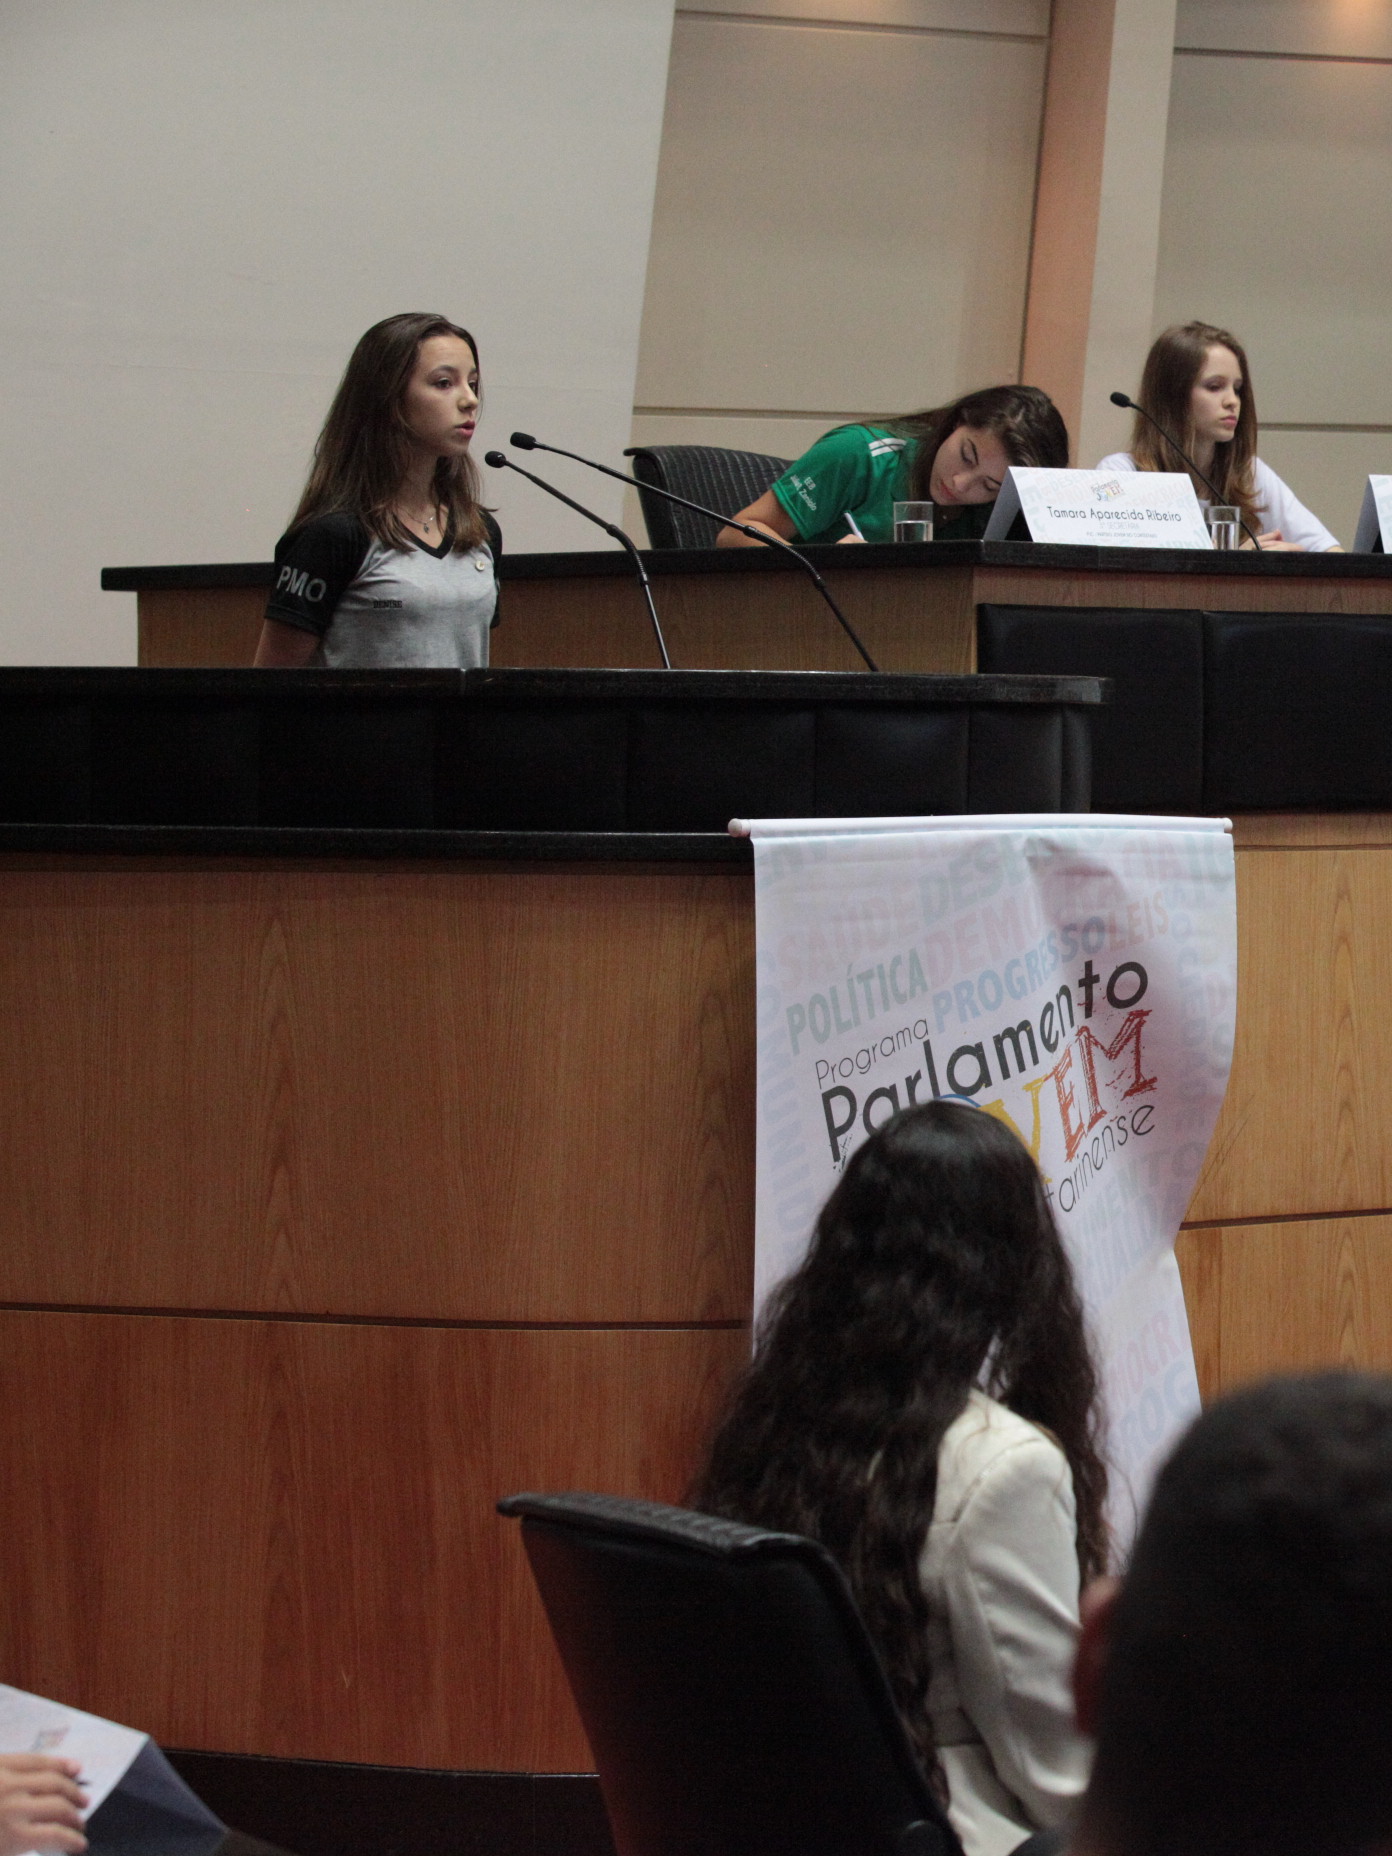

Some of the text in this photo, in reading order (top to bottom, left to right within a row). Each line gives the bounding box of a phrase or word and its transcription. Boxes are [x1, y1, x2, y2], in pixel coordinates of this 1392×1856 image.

[1047, 506, 1182, 522] Tamara Aparecida Ribeiro
[276, 565, 327, 602] PMO
[786, 947, 929, 1058] POLÍTICA
[932, 914, 1106, 1034] PROGRESSO
[814, 1018, 930, 1090] Programa
[821, 960, 1149, 1164] Parlamento
